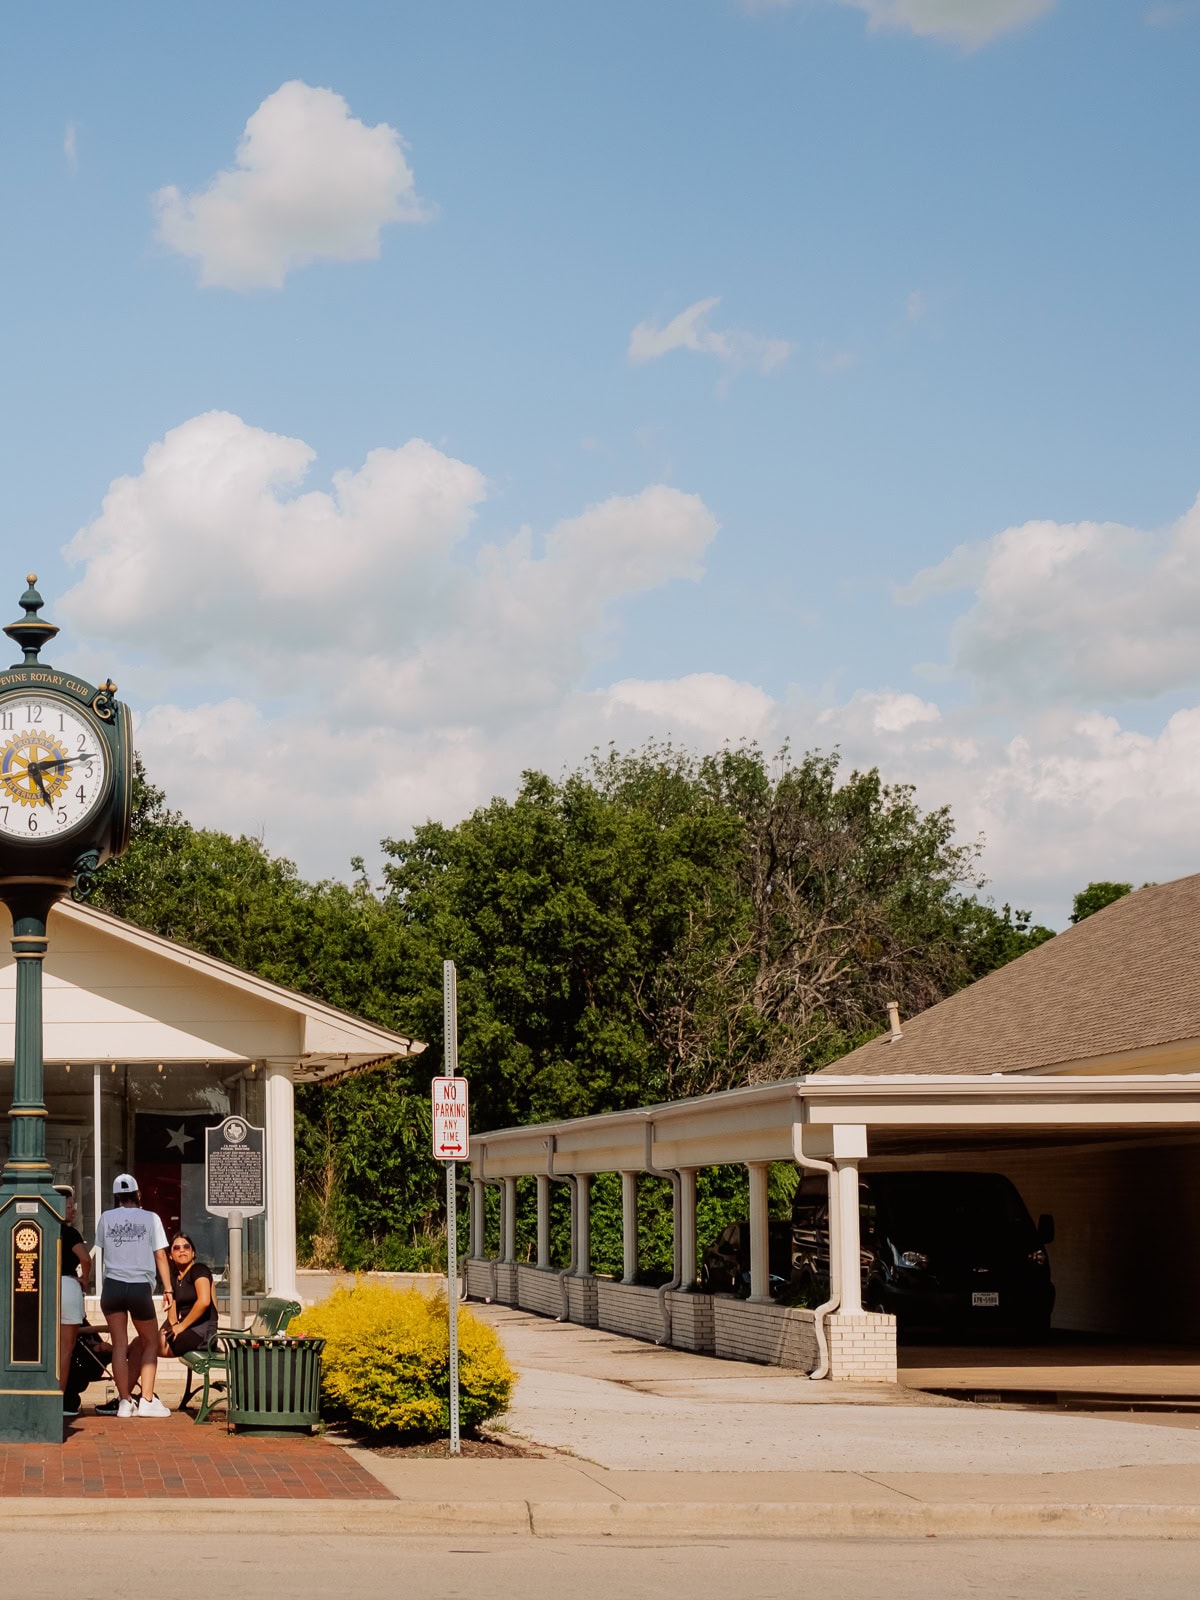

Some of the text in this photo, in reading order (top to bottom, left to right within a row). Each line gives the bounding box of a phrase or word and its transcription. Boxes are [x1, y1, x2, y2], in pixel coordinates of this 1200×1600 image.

[30, 672, 65, 686] ROTARY
[65, 680, 90, 697] CLUB
[1, 712, 14, 731] 11
[26, 705, 44, 723] 12
[58, 713, 65, 732] 1
[17, 737, 49, 748] ROTARY
[76, 733, 87, 753] 2
[84, 759, 94, 779] 3
[75, 784, 87, 804] 4
[28, 812, 38, 832] 6
[56, 805, 68, 825] 5
[444, 1086, 456, 1100] NO
[435, 1103, 466, 1118] PARKING
[444, 1120, 457, 1130] ANY
[443, 1132, 459, 1142] TIME
